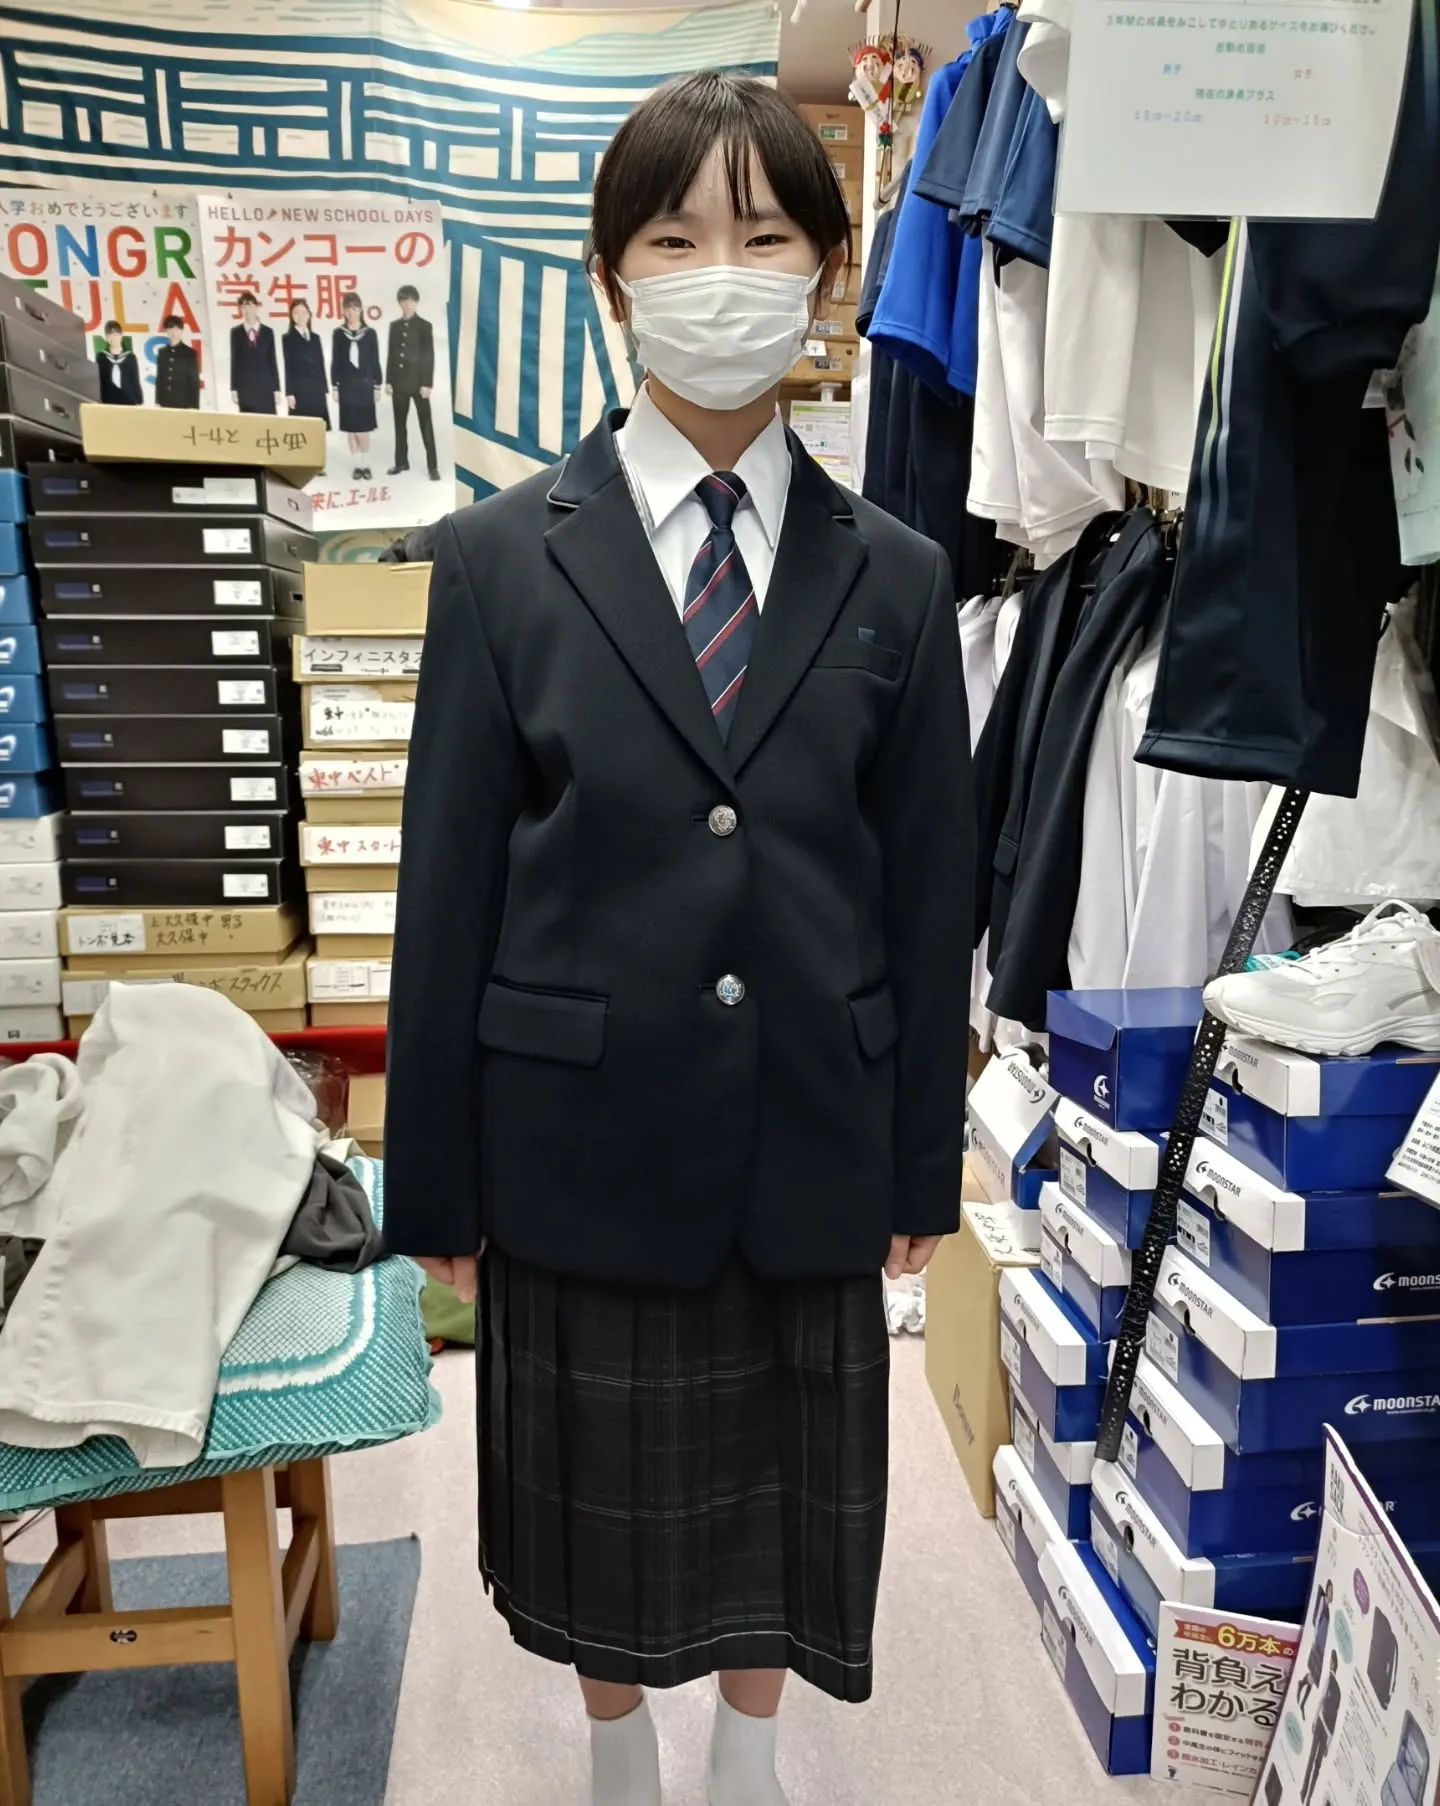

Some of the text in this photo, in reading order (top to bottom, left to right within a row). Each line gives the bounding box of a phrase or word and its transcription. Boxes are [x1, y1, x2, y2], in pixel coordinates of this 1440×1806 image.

[208, 206, 433, 223] HELLO NEW SCHOOL DAYS
[213, 226, 435, 269] カンコーの
[216, 273, 382, 321] 学生服。
[1172, 1648, 1284, 1697] 背負え
[1170, 1682, 1279, 1727] わかる
